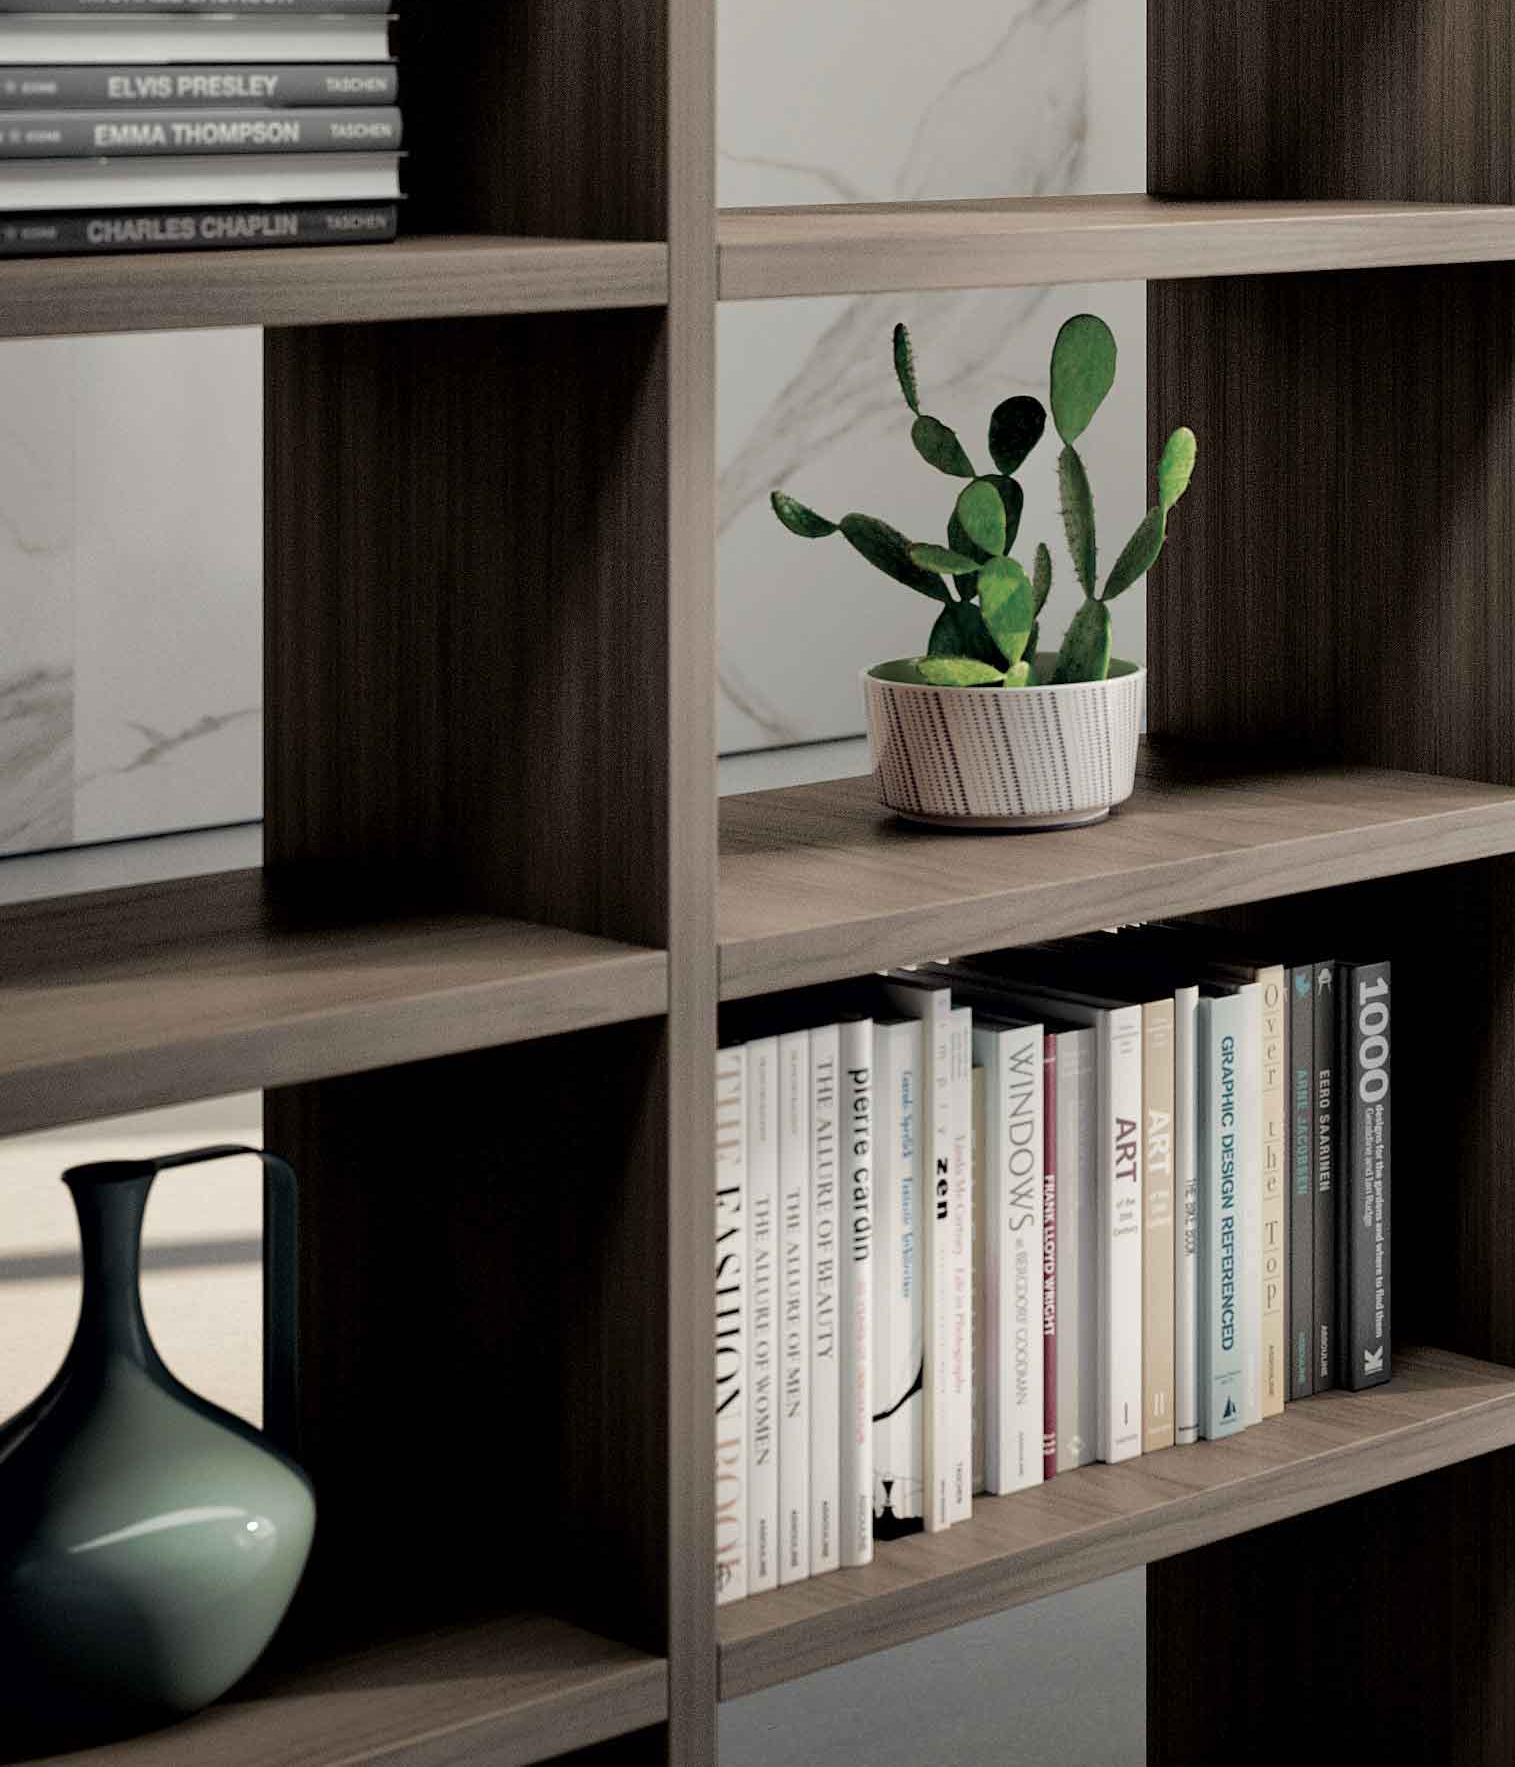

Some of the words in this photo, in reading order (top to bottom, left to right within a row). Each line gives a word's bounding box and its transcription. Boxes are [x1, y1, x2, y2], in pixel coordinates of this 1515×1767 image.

[107, 74, 173, 98] ELVIS
[176, 74, 279, 98] PRESLEY
[92, 123, 168, 147] EMMA
[170, 120, 301, 145] THOMPSON
[85, 217, 196, 243] CHARLES
[199, 214, 300, 240] CHAPLIN
[1359, 976, 1390, 1104] 1000
[816, 1060, 834, 1112] THE
[847, 1067, 874, 1155] pierre
[1220, 1035, 1235, 1127] GRAPHIC
[1319, 1068, 1331, 1108] EERO
[816, 1116, 834, 1214] ALLURE
[1115, 1116, 1138, 1183] ART
[1220, 1133, 1235, 1210] DESIGN
[1319, 1112, 1331, 1192] SAARINEN
[852, 1166, 874, 1263] cardin
[1043, 1173, 1056, 1223] FRANK
[816, 1219, 834, 1255] OF
[1043, 1225, 1056, 1275] LLOYD
[816, 1259, 834, 1360] BEAUTY
[1043, 1276, 1056, 1336] WRIGHT
[1220, 1215, 1235, 1351] REFERENCED
